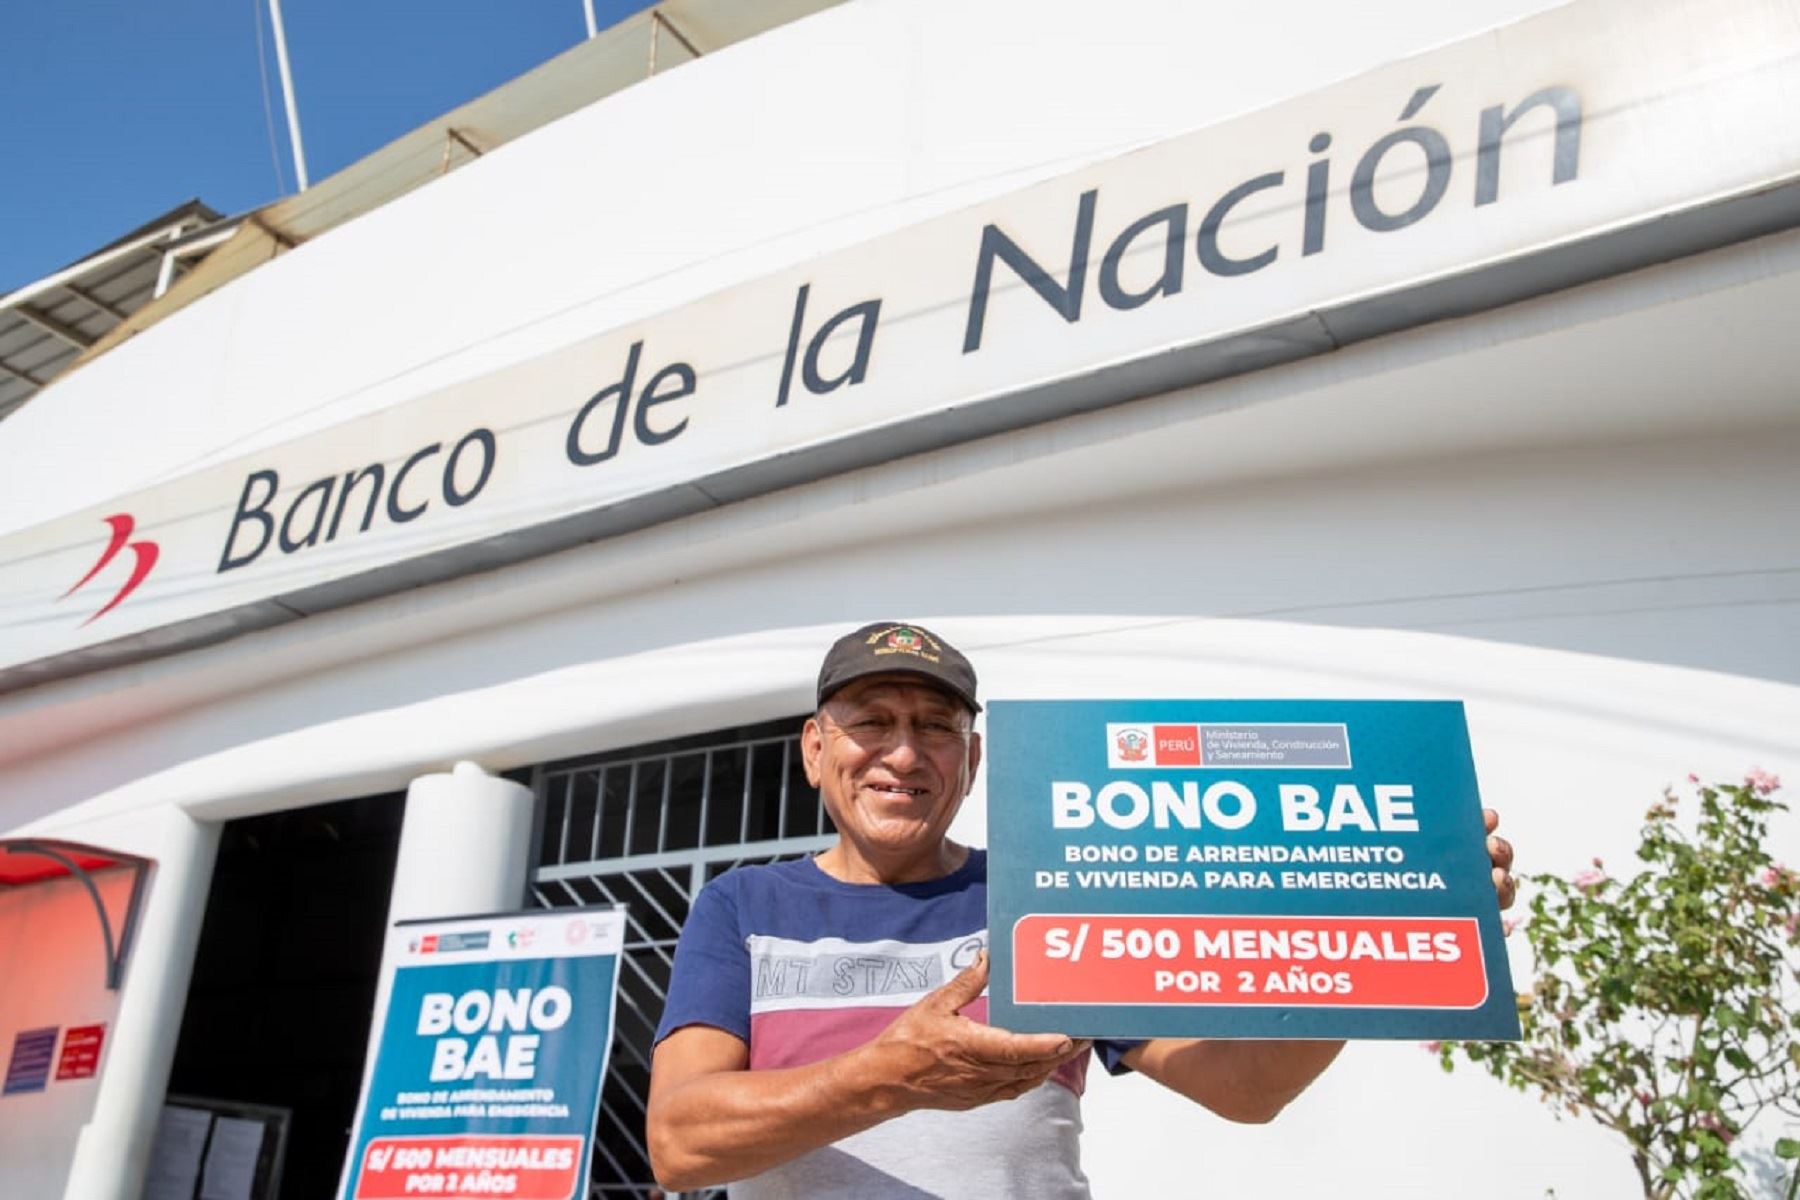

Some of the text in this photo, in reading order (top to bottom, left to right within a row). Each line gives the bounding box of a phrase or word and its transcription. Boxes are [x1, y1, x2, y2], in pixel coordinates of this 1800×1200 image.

[217, 83, 1584, 574] Banco de la Nación
[1158, 737, 1195, 752] PERÚ
[1206, 730, 1259, 740] Ministerio
[1206, 739, 1340, 751] de Vivienda, Construcción
[1206, 750, 1285, 761] y Saneamiento
[1051, 780, 1420, 832] BONO BAE
[1065, 845, 1404, 864] BONO DE ARRENDAMIENTO
[1035, 871, 1447, 890] DE VIVIENDA PARA EMERGENCIA
[1044, 923, 1461, 962] S/ 500 MENSUALES
[832, 955, 937, 996] STAY
[1154, 965, 1353, 994] POR 2 AÑOS
[416, 985, 572, 1036] BONO
[429, 1034, 540, 1083] BAE
[367, 1146, 574, 1173] S/ 500 MENSUALES
[405, 1173, 445, 1193] POR
[460, 1169, 517, 1194] AÑOS
